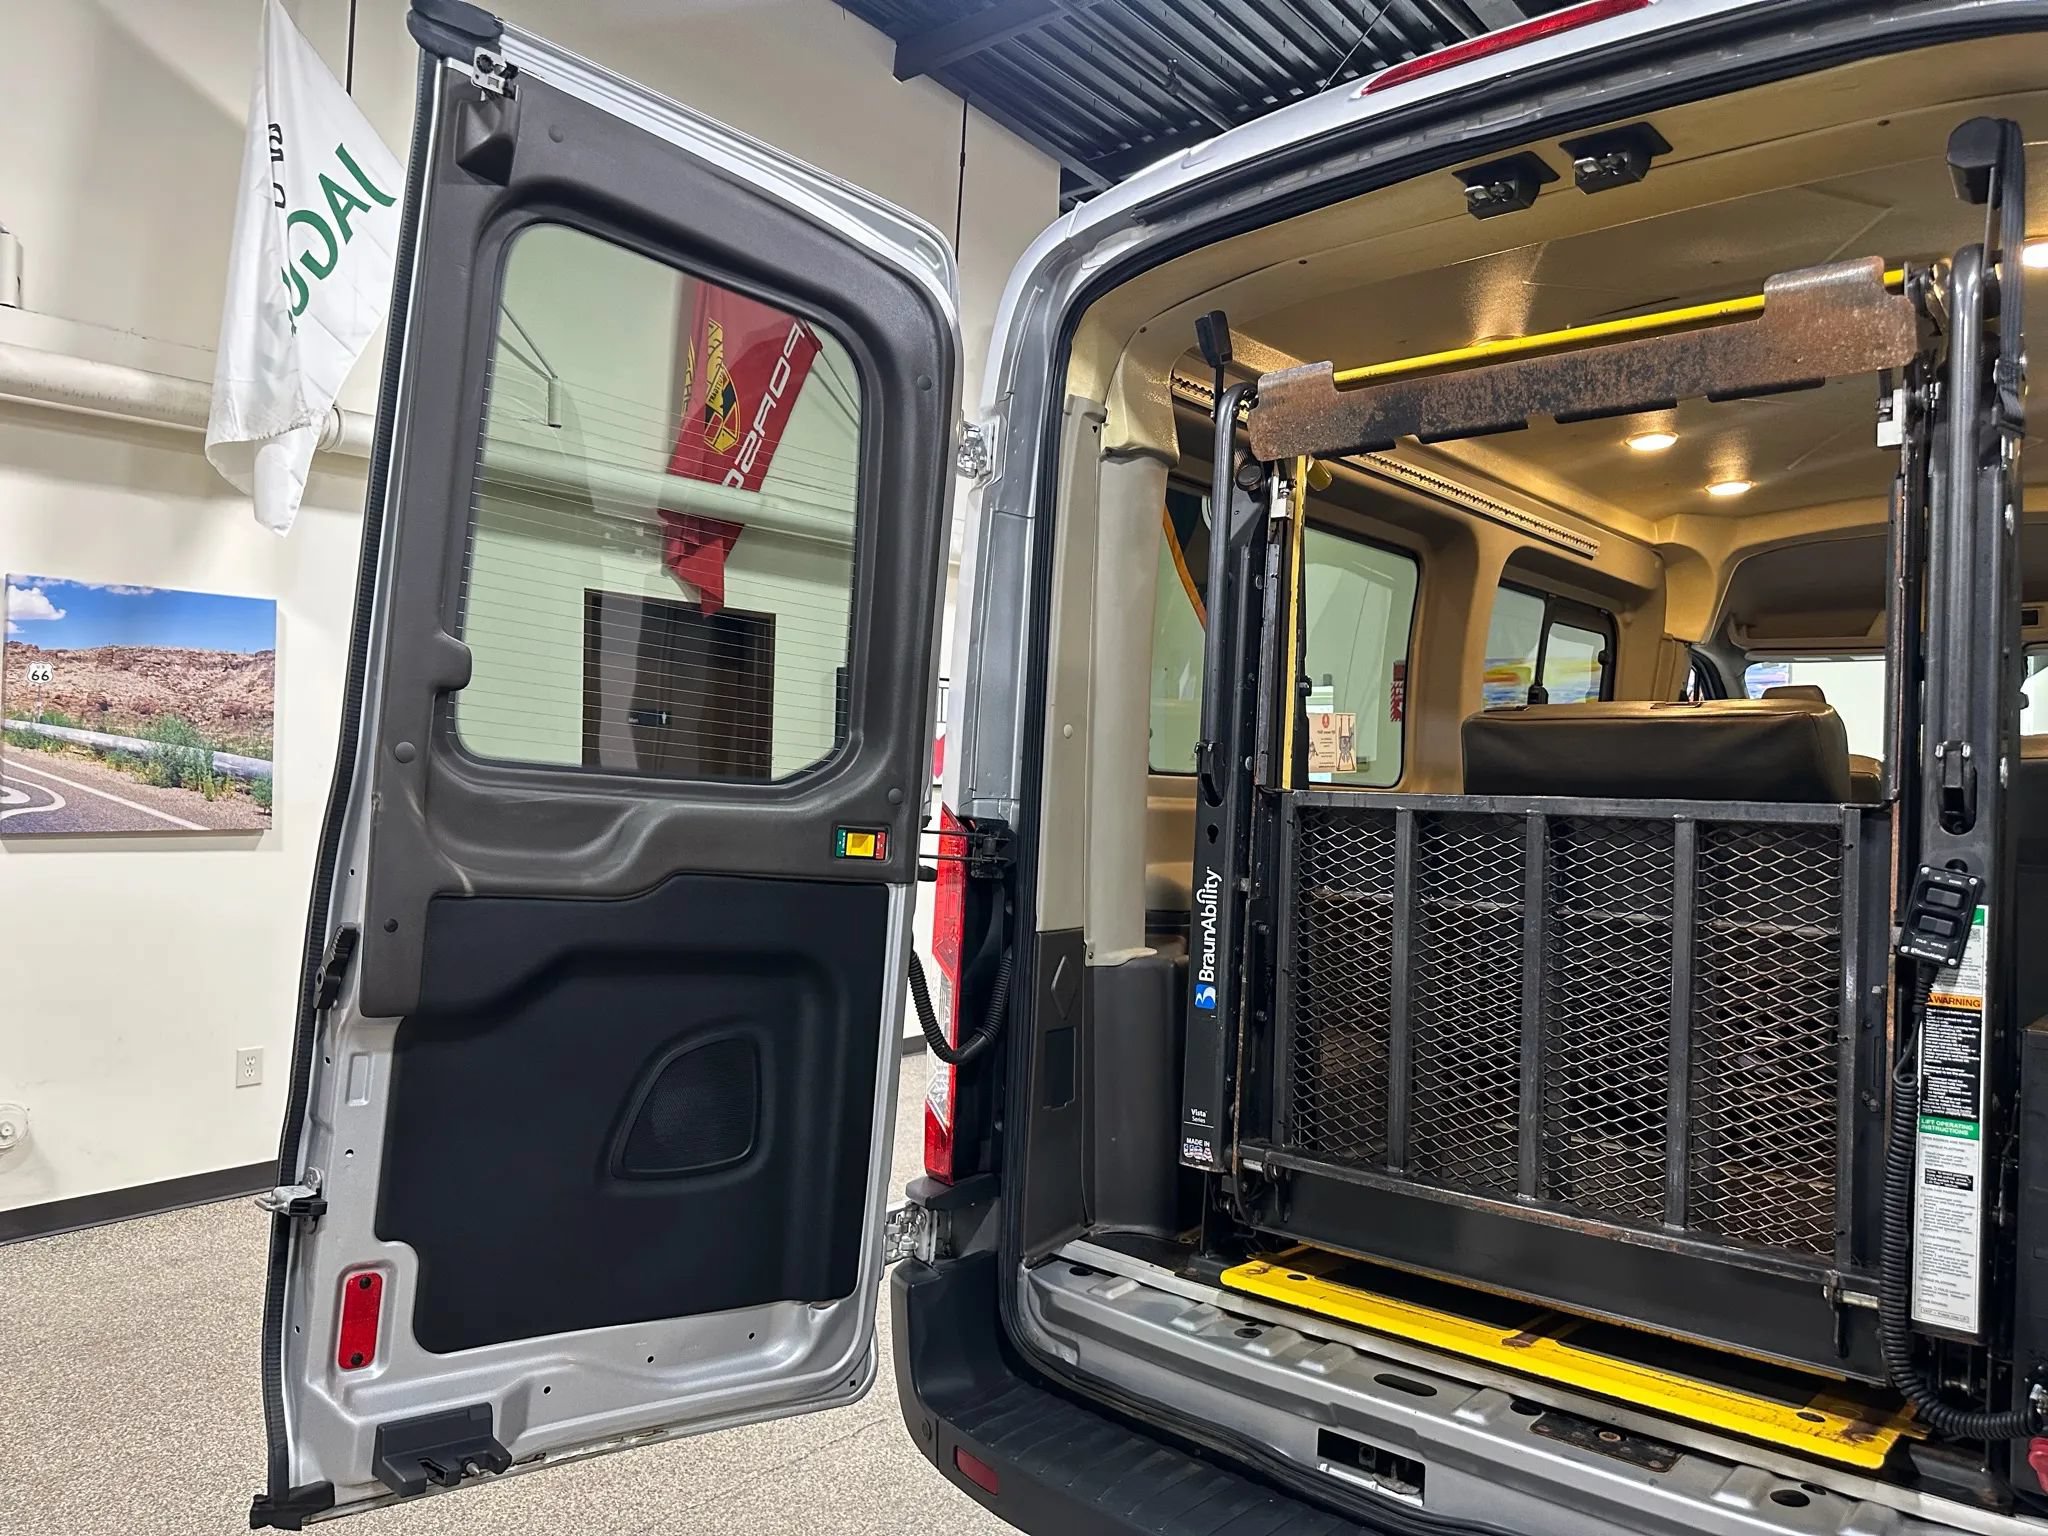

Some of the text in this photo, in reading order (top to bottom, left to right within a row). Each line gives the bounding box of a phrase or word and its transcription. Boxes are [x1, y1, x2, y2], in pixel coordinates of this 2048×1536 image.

[31, 670, 50, 681] 66
[1196, 867, 1223, 982] BraunAbility
[1933, 995, 1981, 1008] WARNING
[1191, 1108, 1207, 1118] Vista
[1191, 1116, 1206, 1124] Series
[1921, 1118, 1974, 1131] LIFT OPERATING
[1186, 1137, 1203, 1146] MADE
